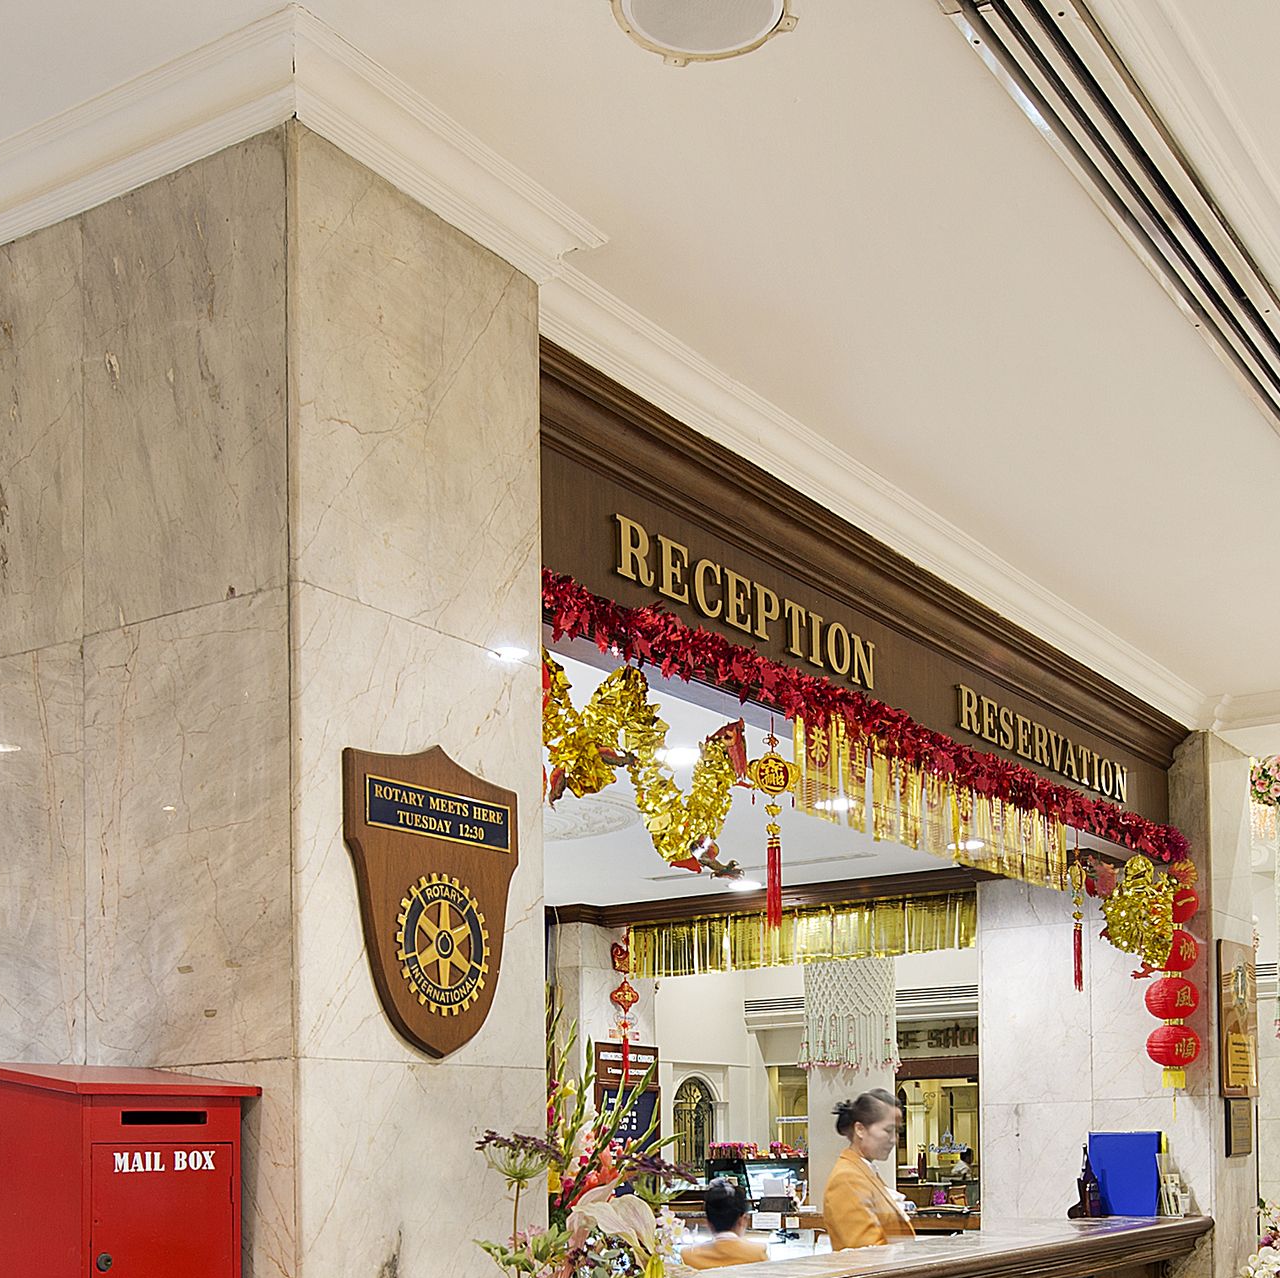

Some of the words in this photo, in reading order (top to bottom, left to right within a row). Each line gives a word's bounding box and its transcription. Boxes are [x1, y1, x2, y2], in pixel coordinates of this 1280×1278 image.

[614, 513, 876, 690] RECEPTION
[956, 683, 1128, 804] RESERVATION
[374, 784, 425, 808] ROTARY
[429, 796, 469, 817] MEETS
[473, 806, 503, 825] HERE
[397, 810, 452, 834] TUESDAY
[459, 824, 485, 841] 12:30
[426, 885, 464, 904] ROTARY
[410, 963, 477, 1003] INTERNATIONAL
[113, 1151, 165, 1173] MAIL
[174, 1150, 216, 1171] BOX
